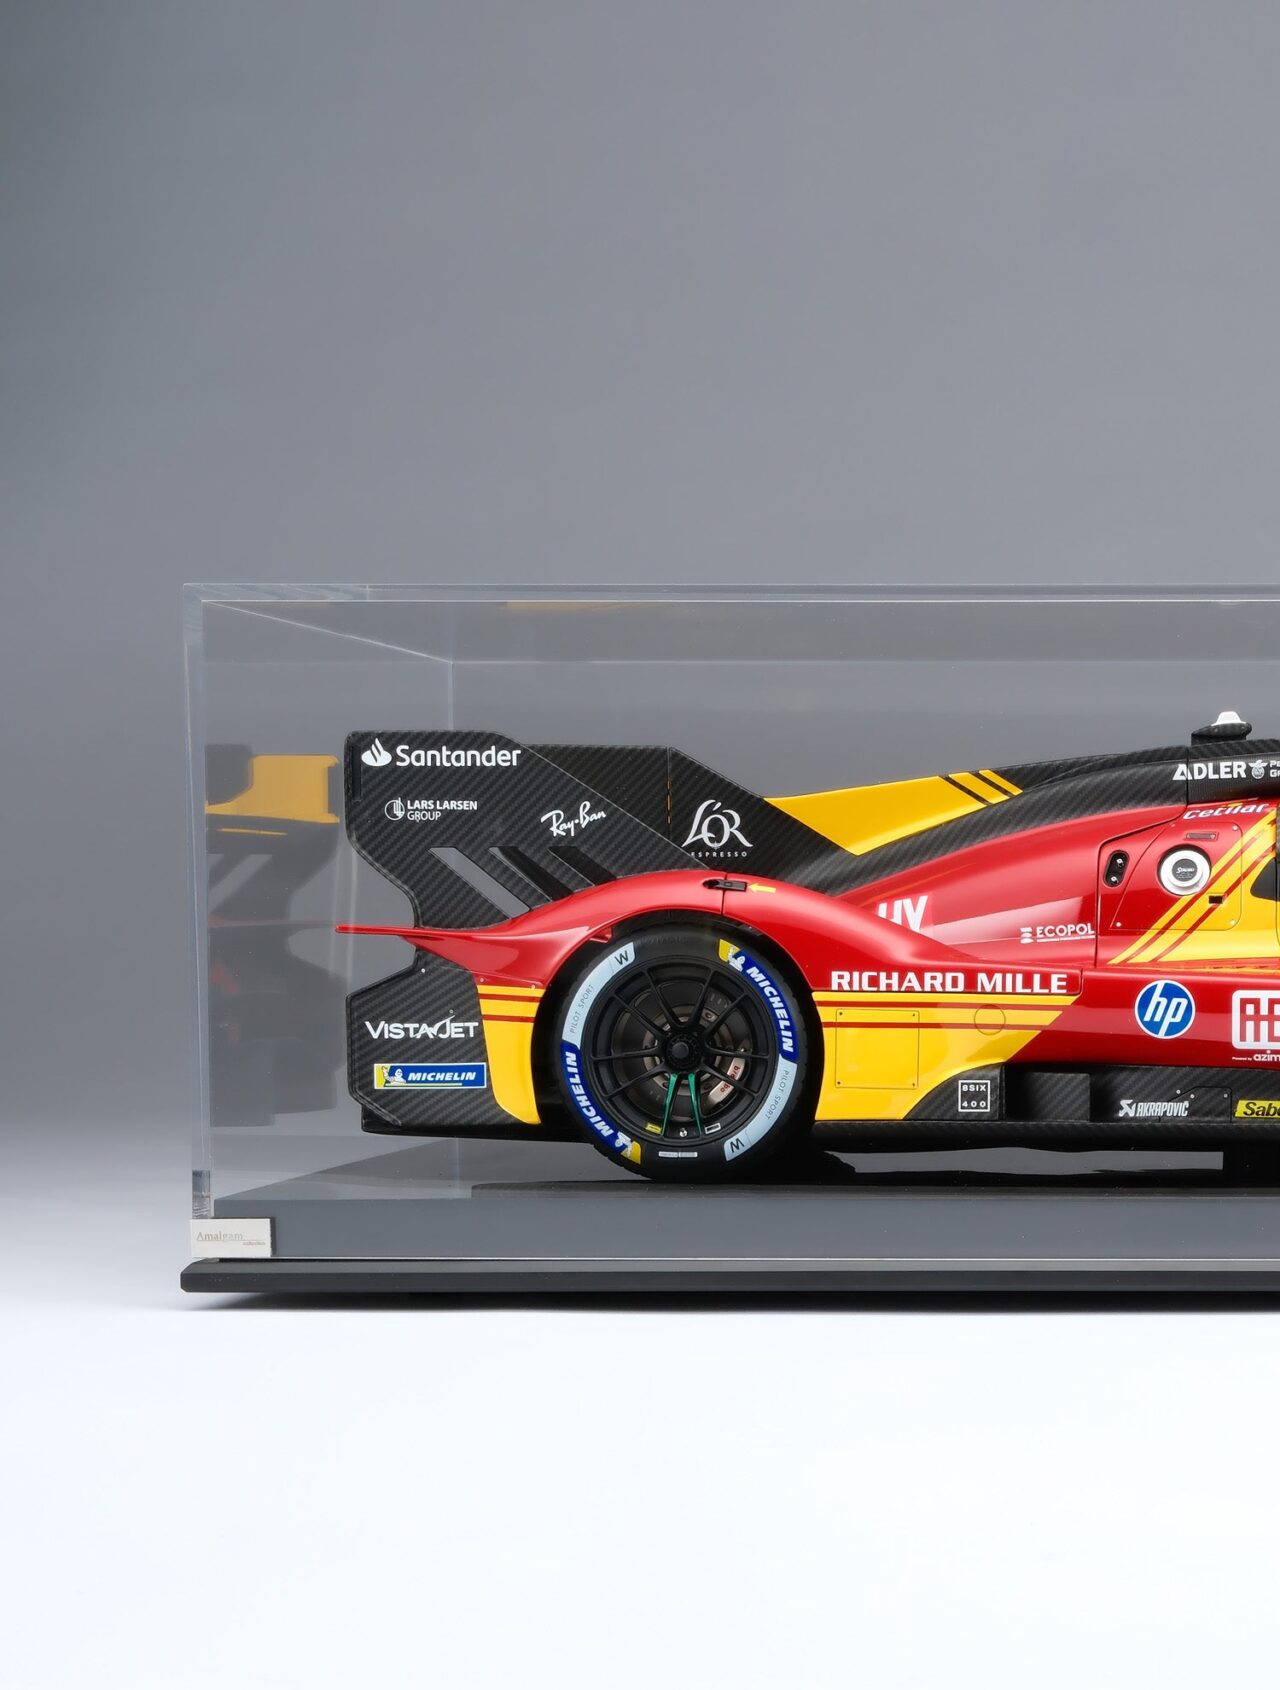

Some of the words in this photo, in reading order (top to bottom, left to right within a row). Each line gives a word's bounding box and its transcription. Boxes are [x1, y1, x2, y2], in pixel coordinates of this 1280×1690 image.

[395, 745, 522, 767] Santander
[1172, 761, 1247, 780] ADLER
[407, 800, 435, 810] LARS
[436, 800, 478, 810] LARSEN
[407, 811, 442, 821] GROUP
[1036, 923, 1095, 937] ECOPOL
[831, 971, 965, 992] RICHARD
[977, 972, 1067, 993] MILLE
[570, 1012, 580, 1034] PILOT
[579, 984, 594, 1009] SPORT
[746, 966, 794, 1053] MICHELIN
[1143, 982, 1188, 1036] hp
[407, 1072, 476, 1081] MICHELIN
[778, 1070, 789, 1092] PILOT
[565, 1052, 614, 1137] MICHELIN
[962, 1100, 986, 1108] 400
[766, 1094, 781, 1120] SPORT
